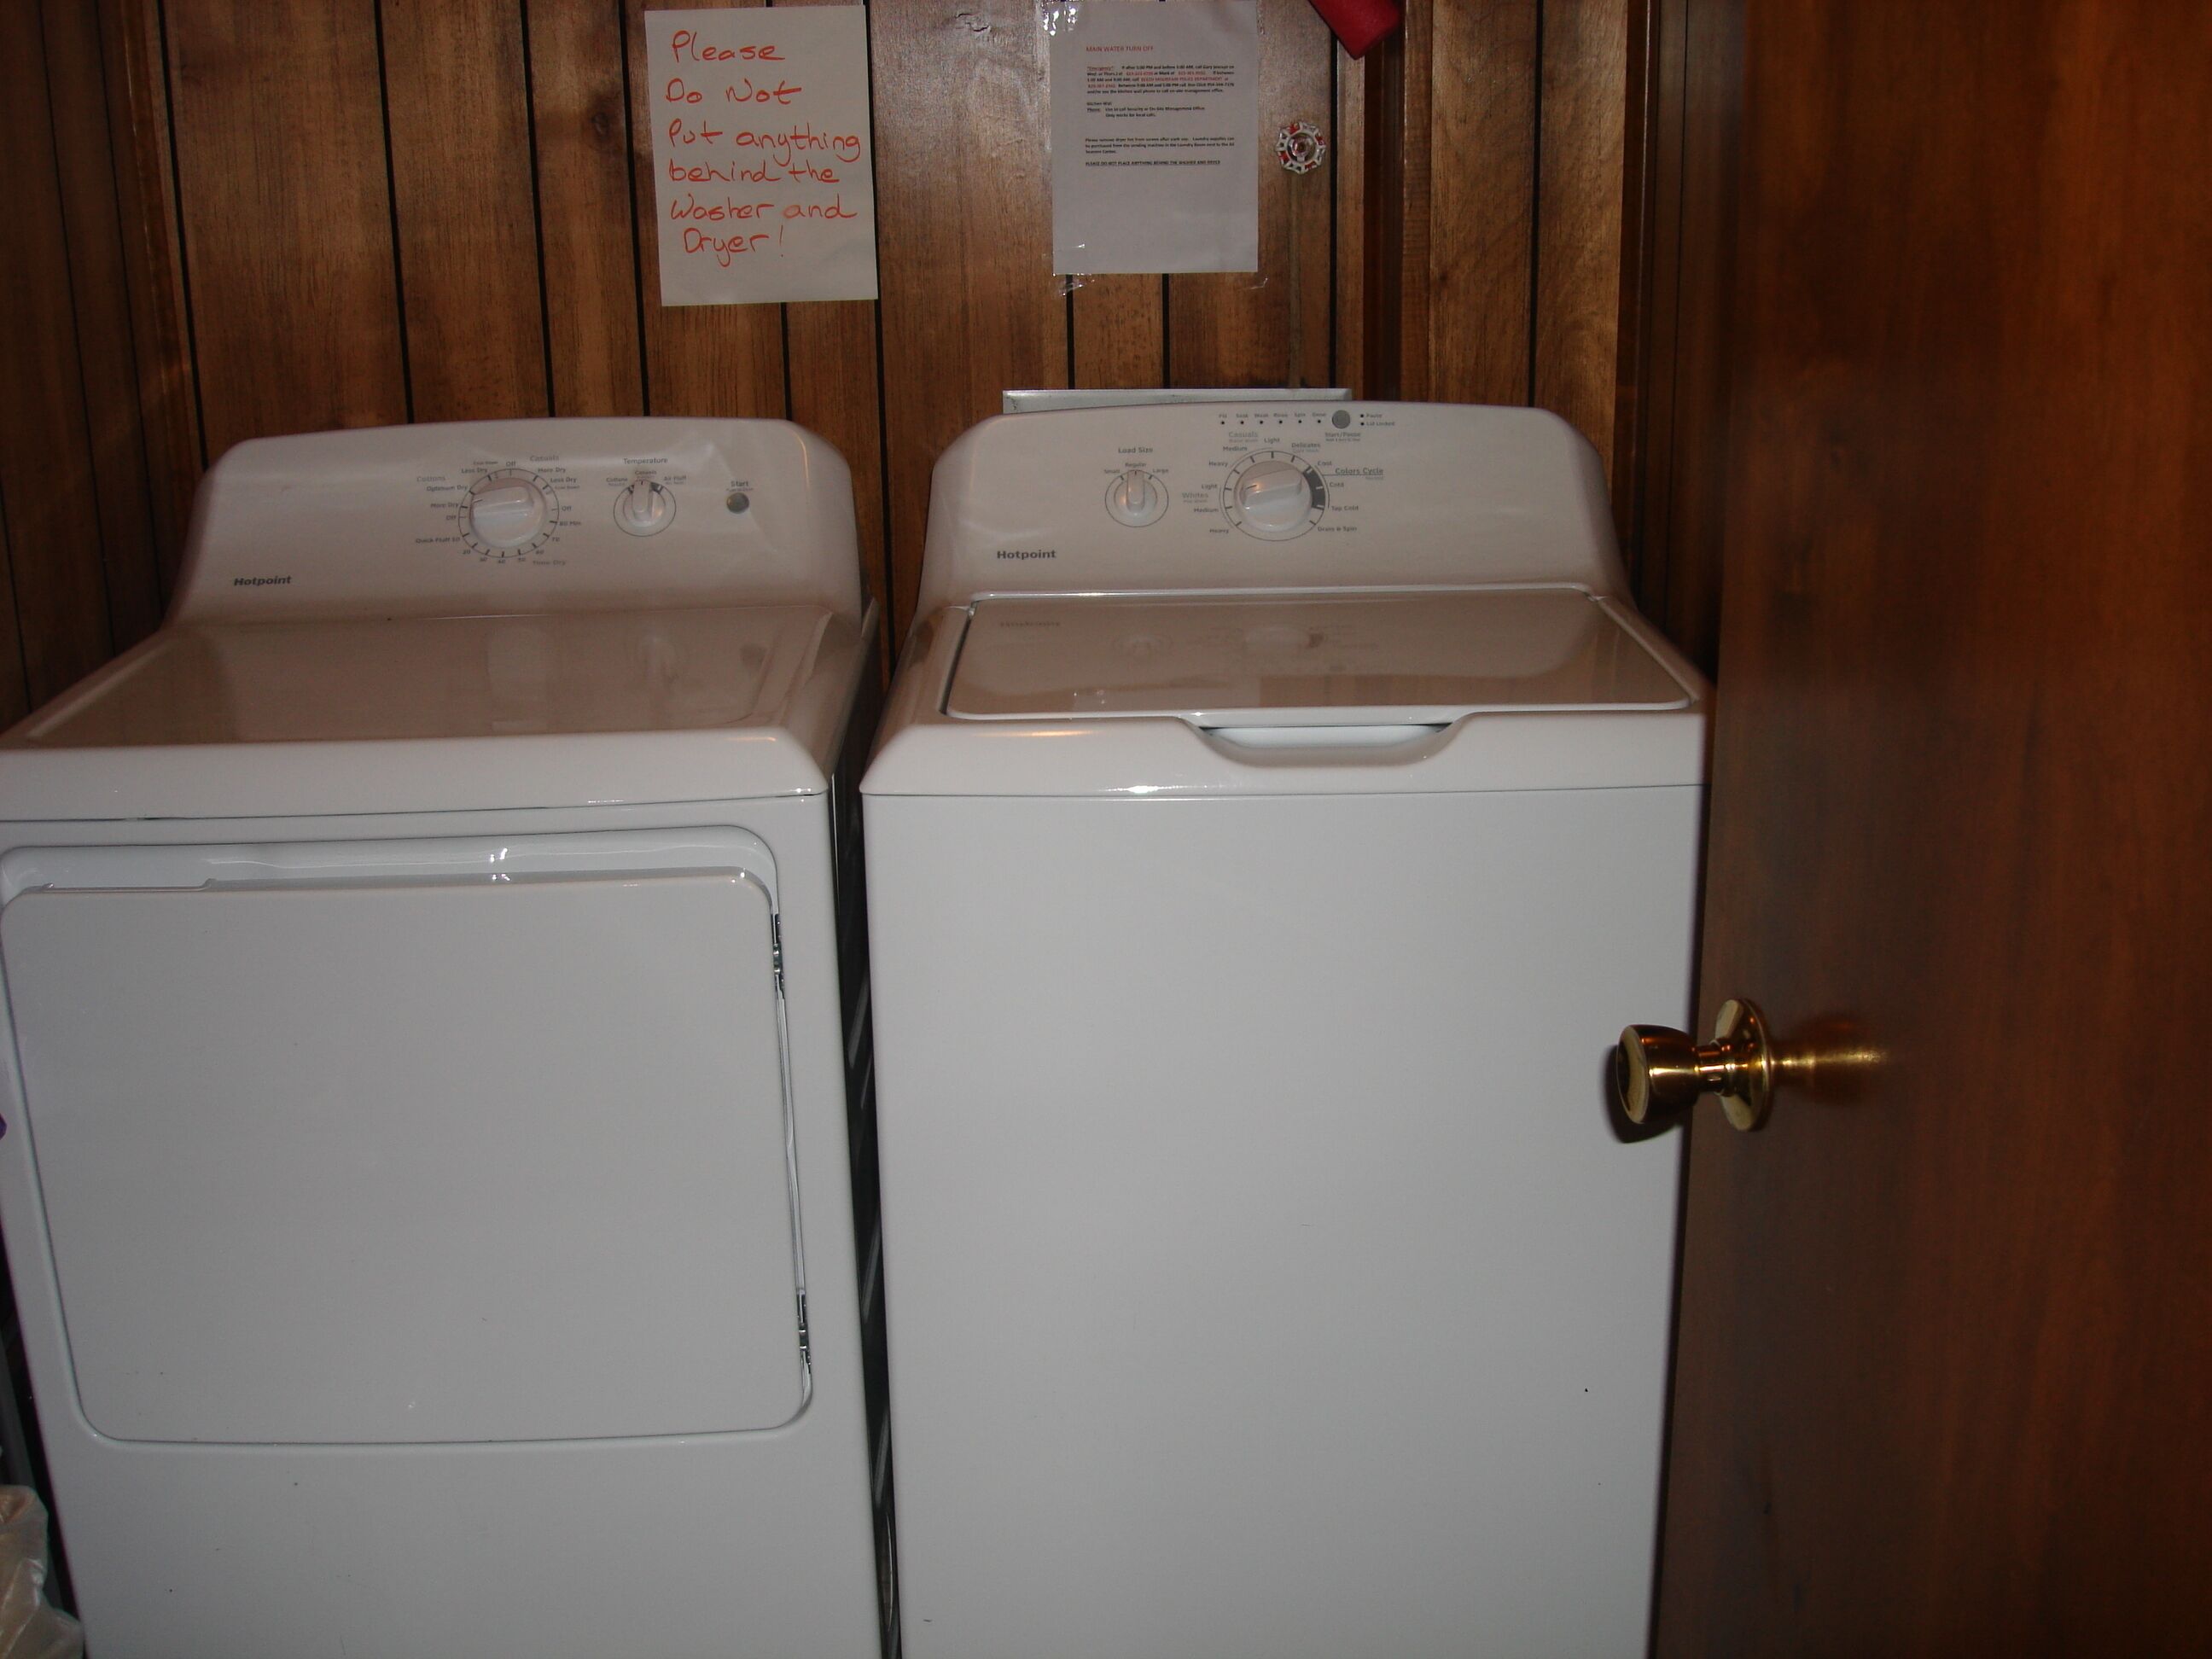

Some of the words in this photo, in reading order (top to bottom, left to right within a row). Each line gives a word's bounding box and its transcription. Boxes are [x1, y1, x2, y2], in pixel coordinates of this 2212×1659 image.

[672, 30, 785, 63] Please
[666, 78, 702, 103] Do
[726, 78, 802, 105] Not
[668, 119, 723, 147] Put
[736, 122, 861, 166] anything
[669, 159, 780, 182] behind
[789, 160, 840, 183] the
[671, 194, 775, 220] Washer
[783, 194, 859, 219] and
[1363, 467, 1384, 475] Cycle
[997, 550, 1057, 560] Hotpoint
[234, 575, 292, 586] Hotpoint
